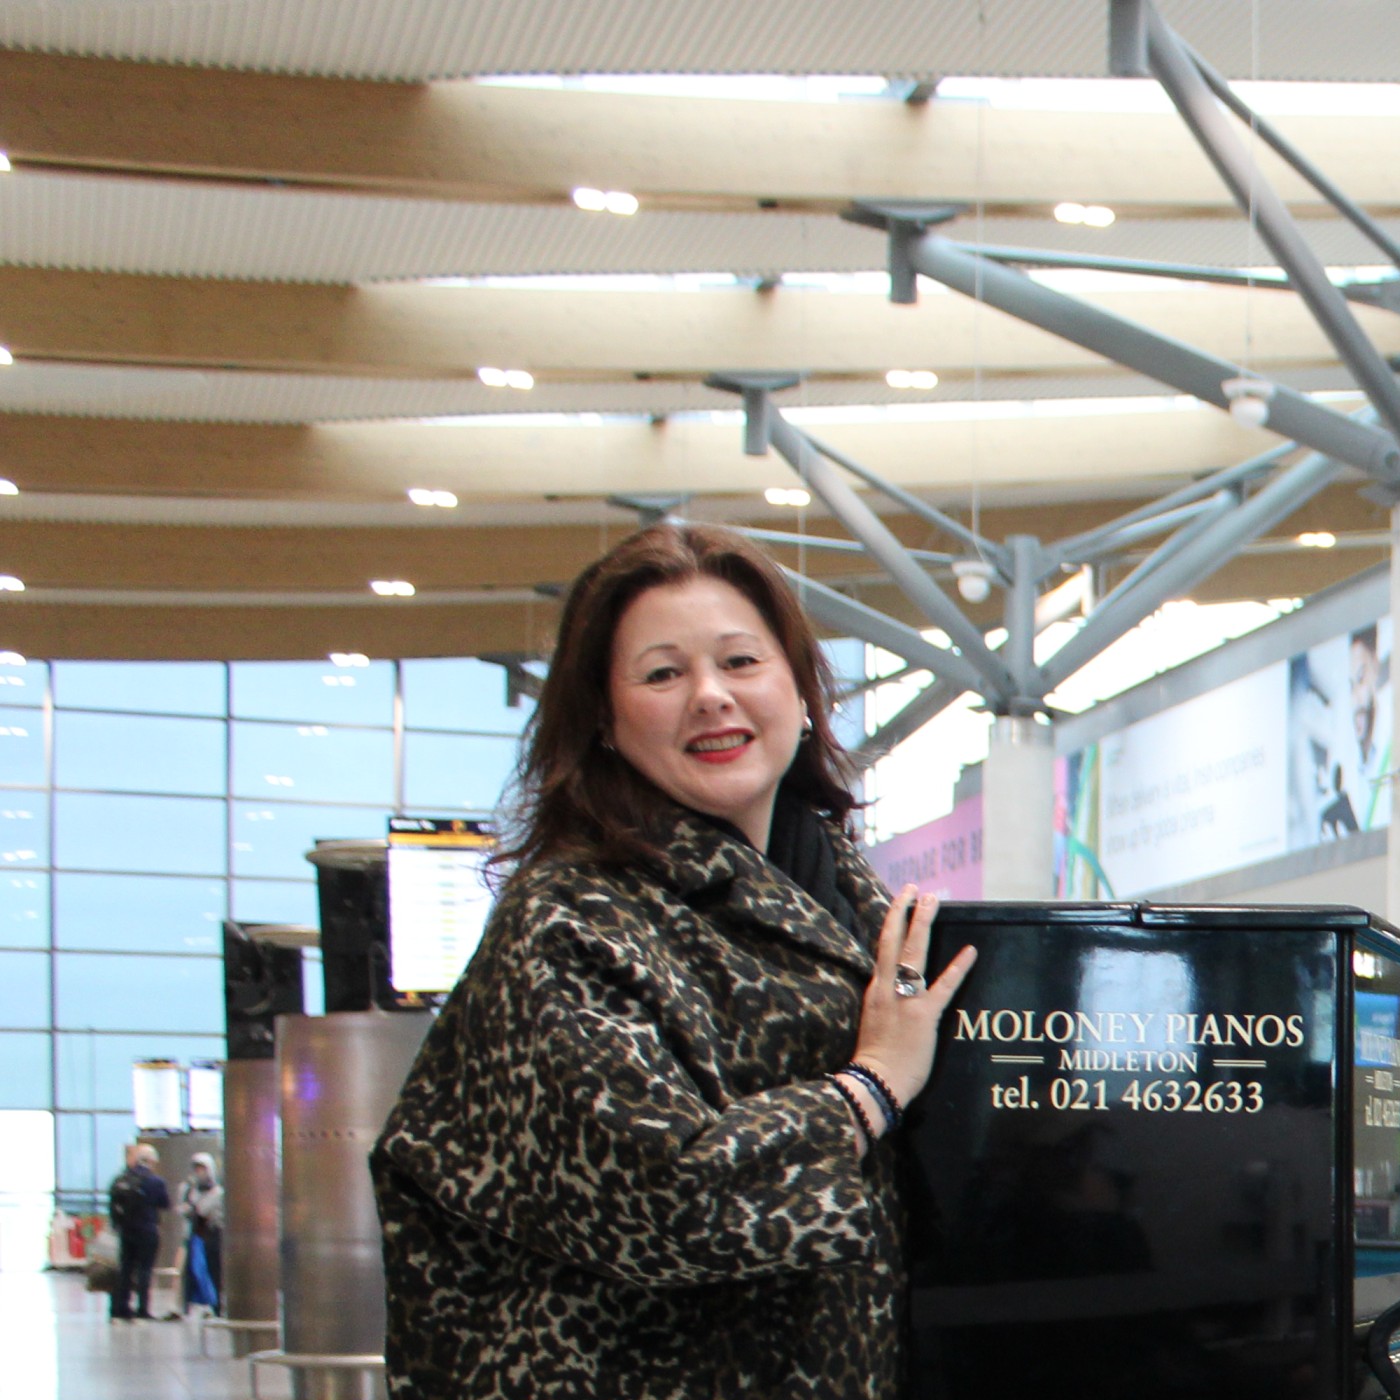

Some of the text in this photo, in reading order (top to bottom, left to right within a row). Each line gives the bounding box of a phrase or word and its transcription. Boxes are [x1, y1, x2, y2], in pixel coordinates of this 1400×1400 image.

[953, 1008, 1305, 1048] MOLONEY PIANOS
[1058, 1048, 1199, 1074] MIDLETON
[991, 1075, 1264, 1114] tel. 021 4632633
